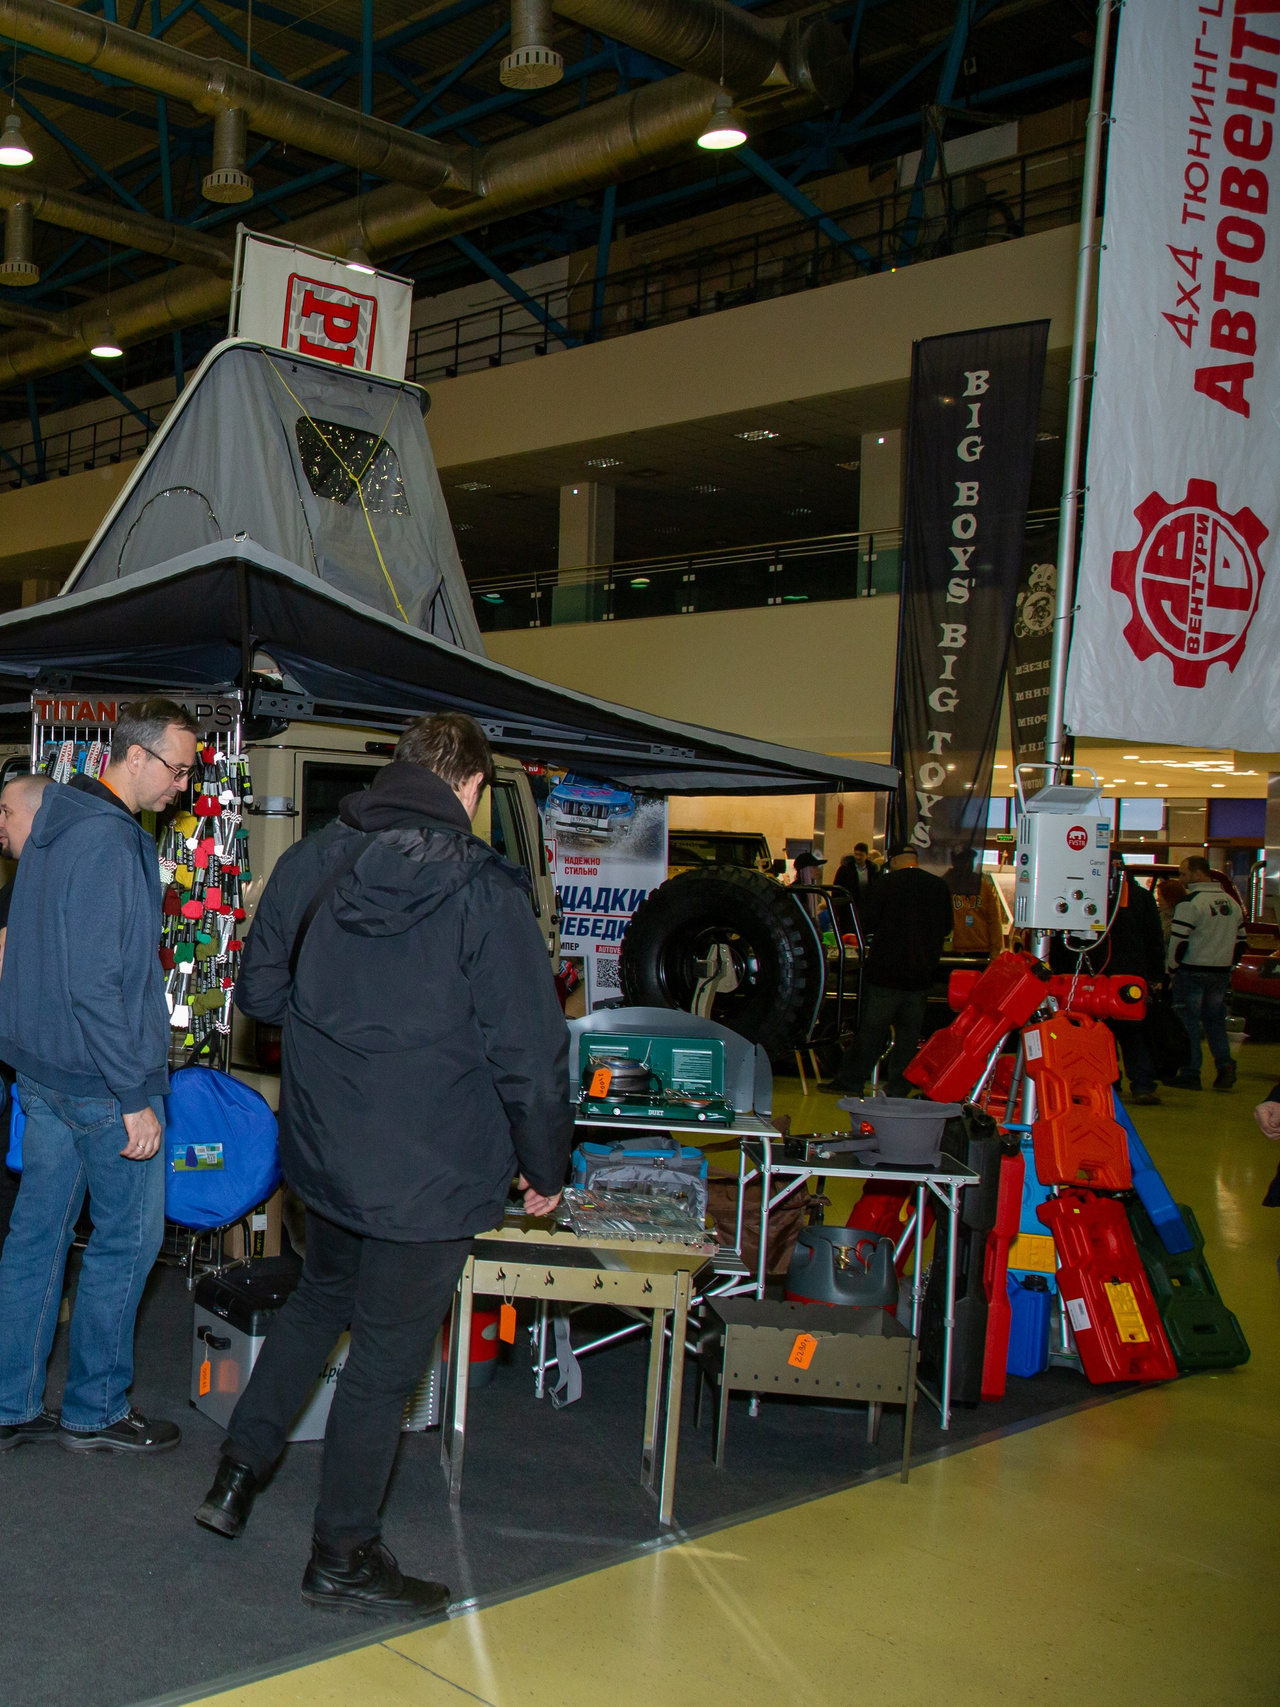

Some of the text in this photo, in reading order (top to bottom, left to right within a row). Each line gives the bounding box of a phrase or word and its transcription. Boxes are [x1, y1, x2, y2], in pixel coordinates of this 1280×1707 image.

[956, 368, 990, 464] BIG
[1186, 513, 1211, 655] ВЕНТУРИ
[928, 622, 967, 713] BIG
[35, 700, 234, 727] TITANPS
[909, 730, 952, 848] TOYS
[564, 857, 601, 866] НАДЕЖНО
[564, 866, 598, 876] СТИЛЬНО
[1091, 868, 1101, 877] 6L
[560, 916, 634, 941] ЕБЕДК
[598, 945, 622, 954] AUTOVE
